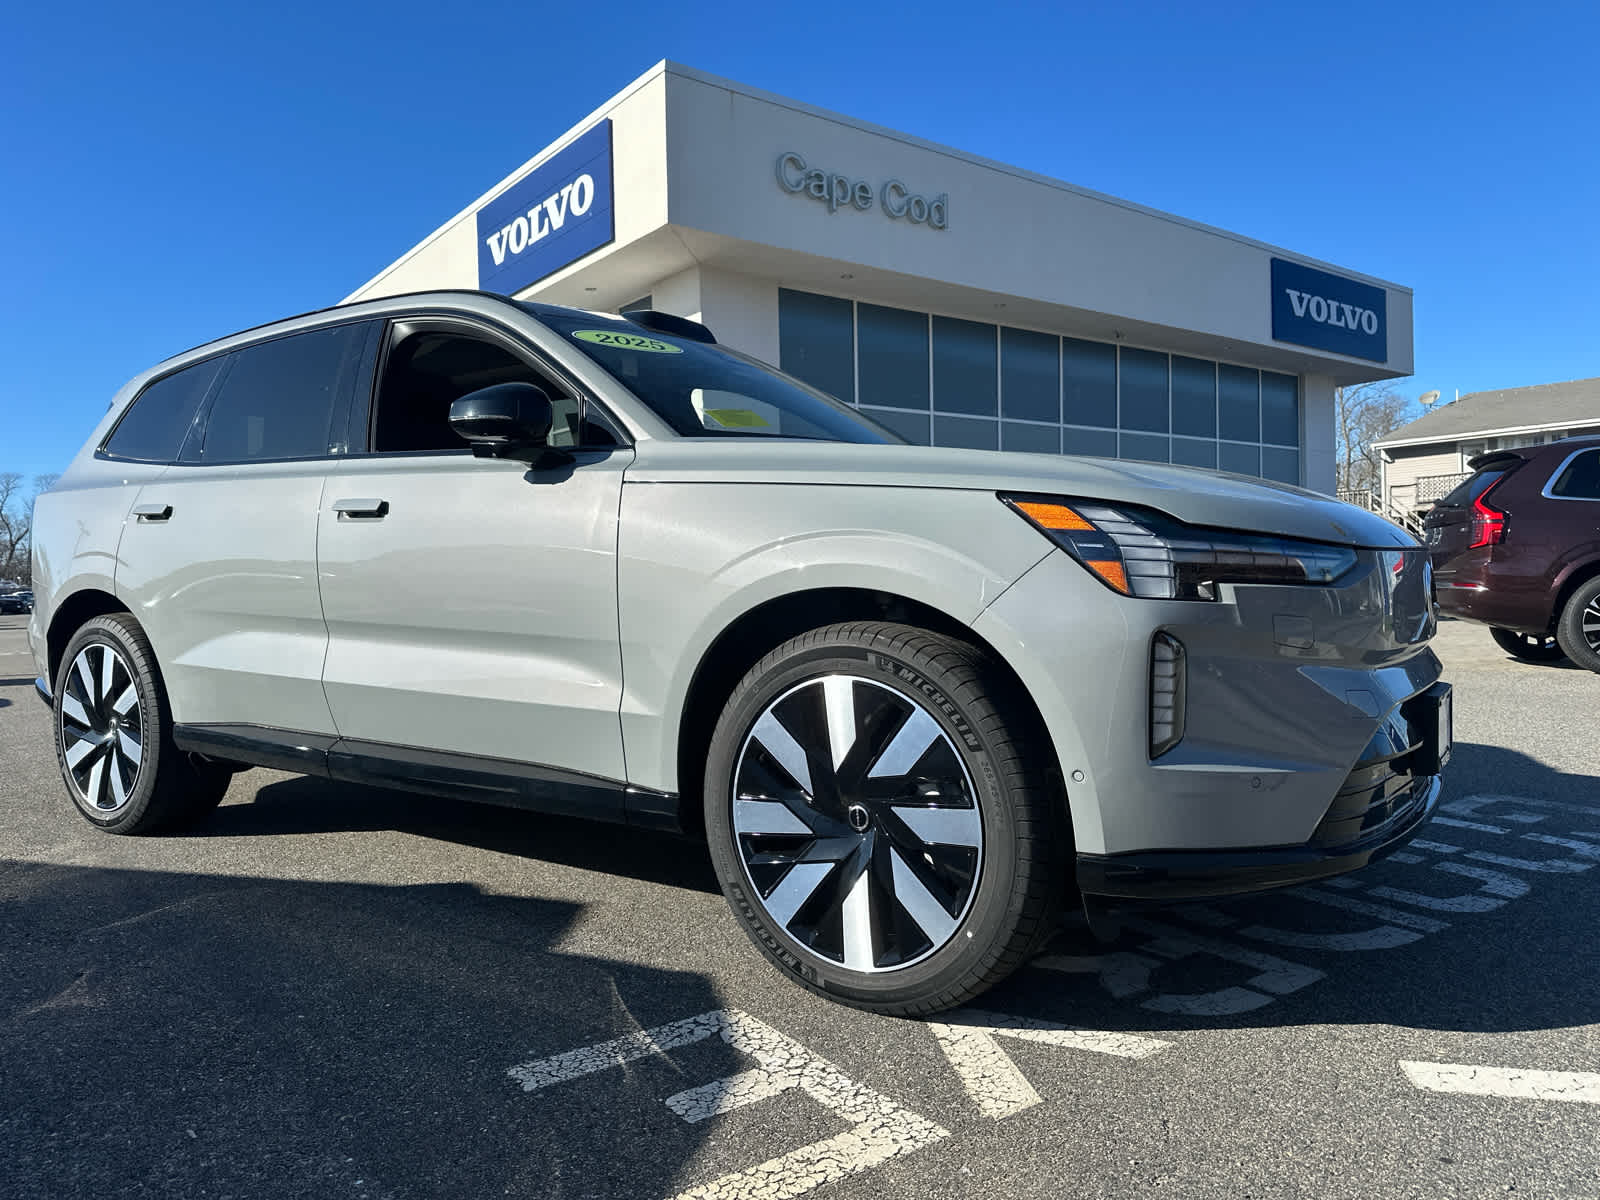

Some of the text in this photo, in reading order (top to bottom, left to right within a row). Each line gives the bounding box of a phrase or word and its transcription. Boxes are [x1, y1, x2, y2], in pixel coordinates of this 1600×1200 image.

[486, 174, 594, 266] VOLVO
[776, 152, 951, 230] Cape Cod
[595, 333, 666, 351] 2025
[1285, 288, 1378, 335] VOLVO
[899, 666, 978, 747] MICHELIN
